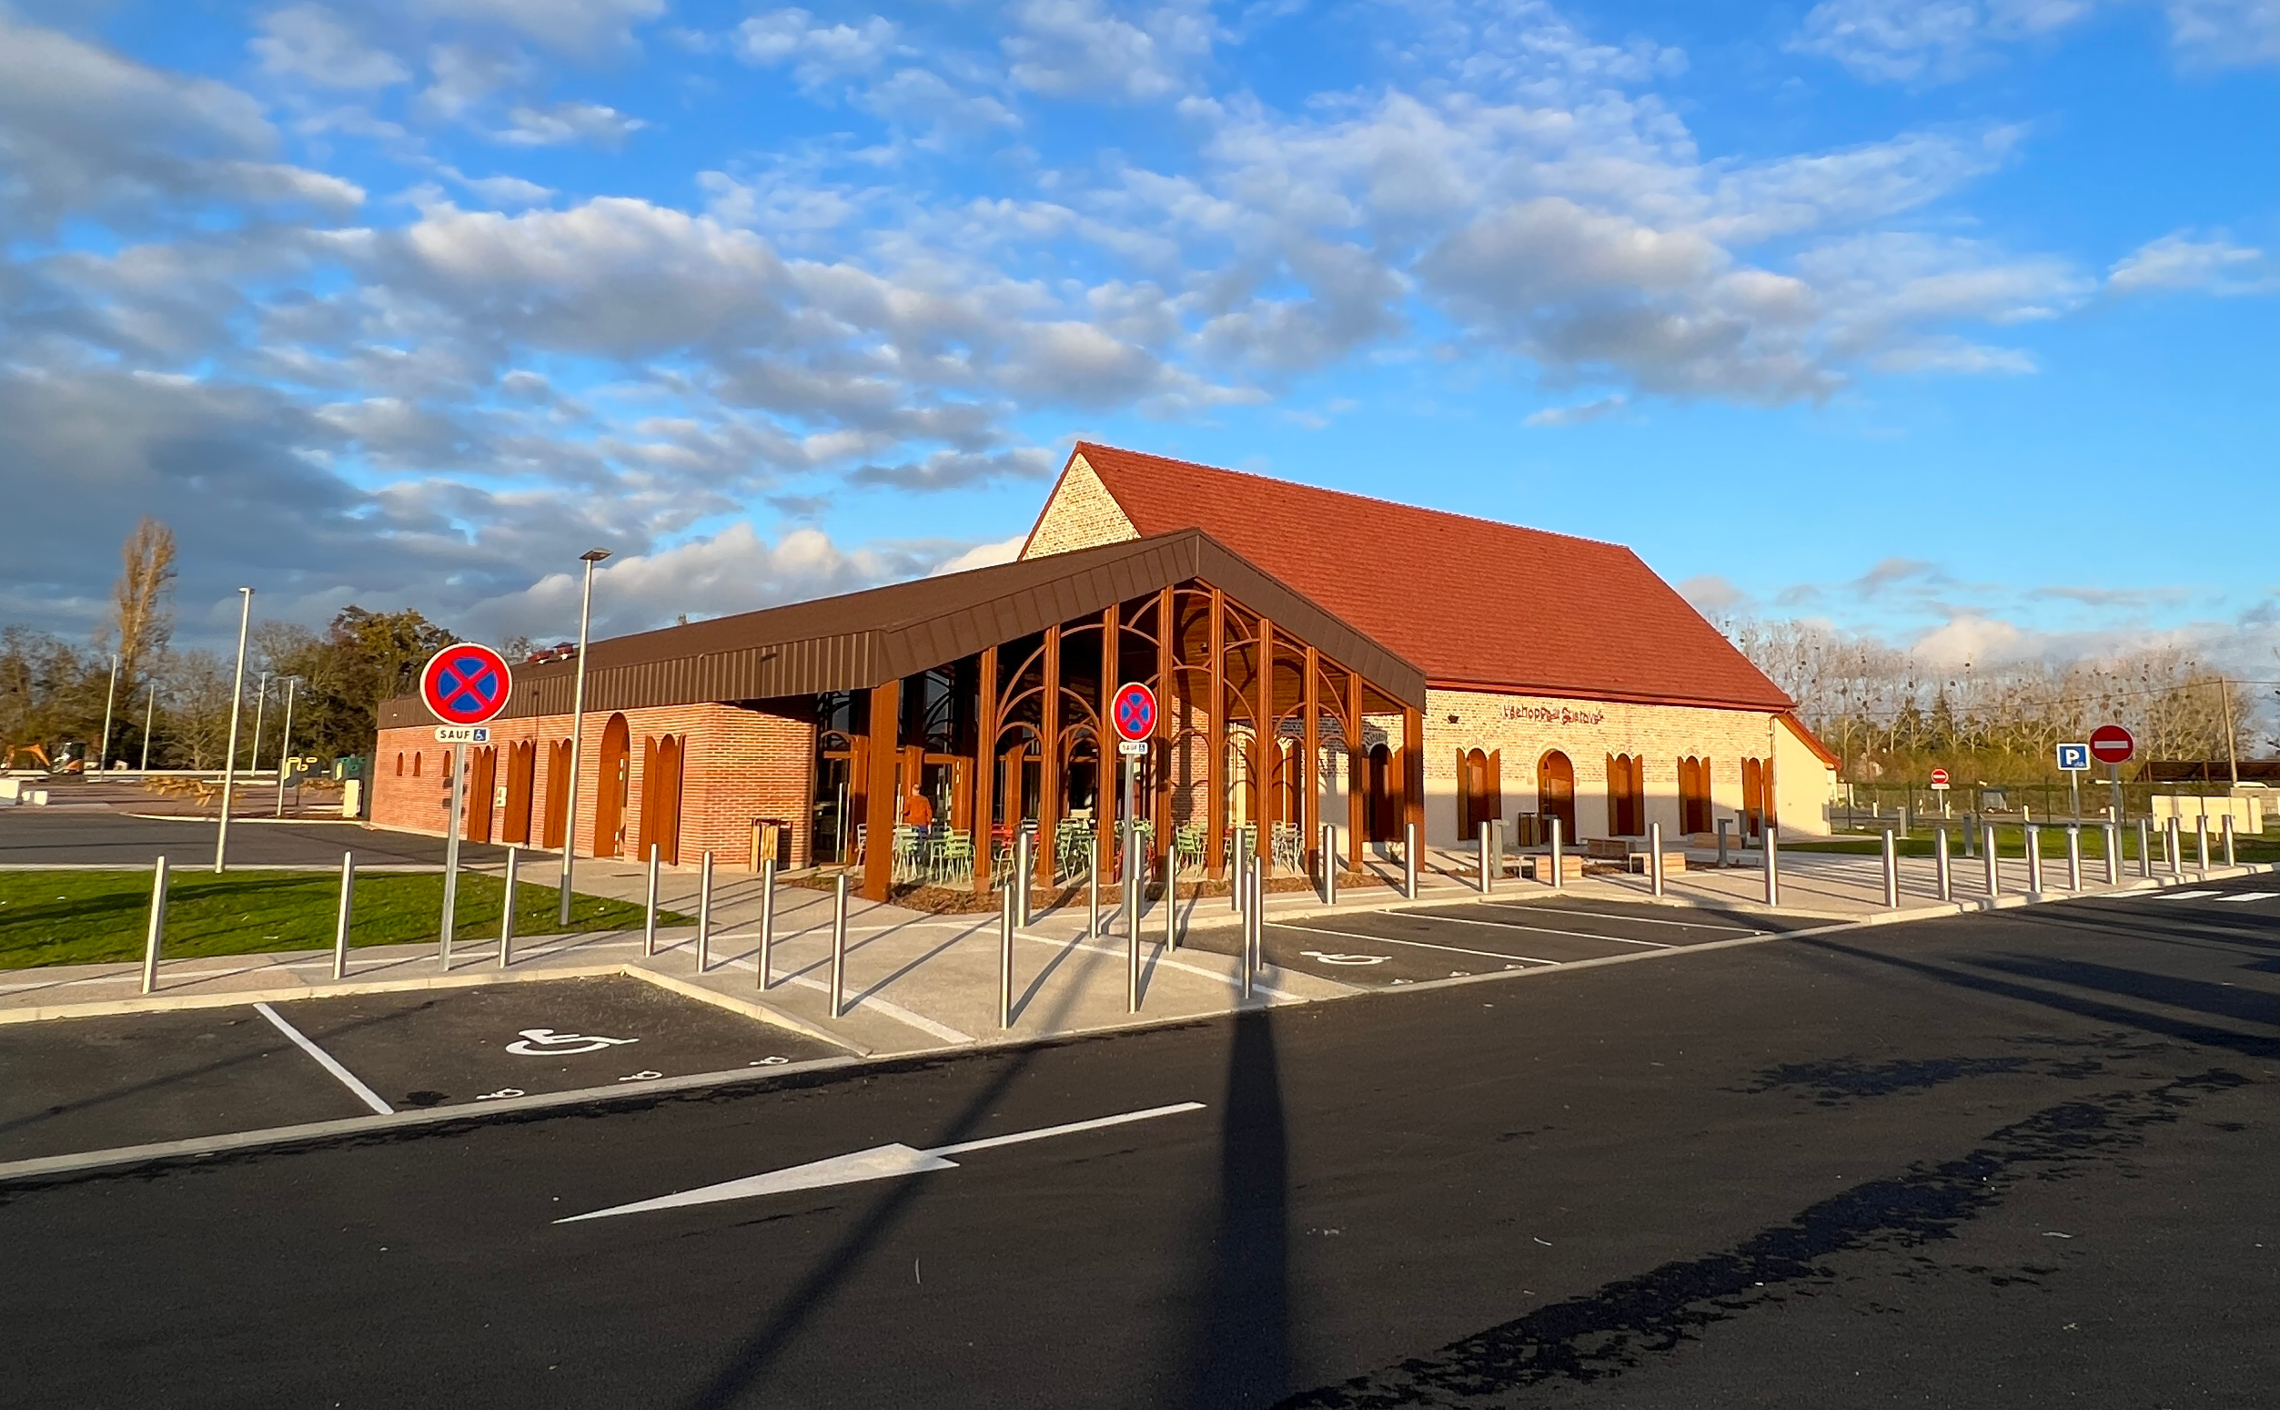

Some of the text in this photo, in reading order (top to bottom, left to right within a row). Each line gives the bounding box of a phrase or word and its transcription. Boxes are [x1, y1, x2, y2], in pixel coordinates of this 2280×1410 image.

[440, 730, 470, 739] SAUF
[1122, 744, 1137, 752] SAUF
[2065, 749, 2080, 765] P
